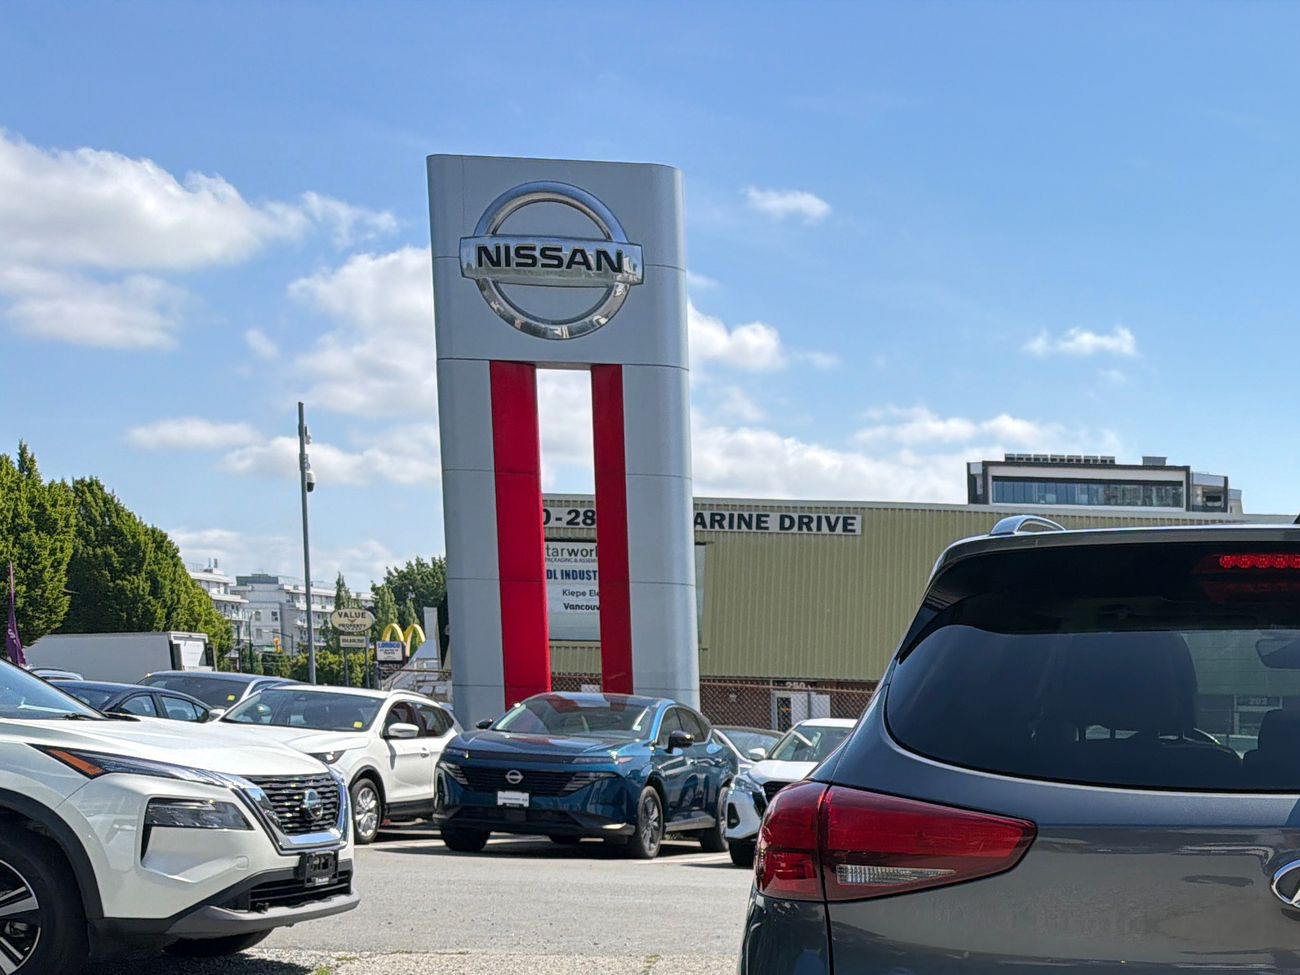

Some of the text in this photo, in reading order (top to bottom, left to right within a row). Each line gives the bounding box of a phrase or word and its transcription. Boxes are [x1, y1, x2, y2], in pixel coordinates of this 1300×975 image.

[477, 244, 624, 274] NISSAN
[694, 511, 857, 533] ARINE DRIVE
[560, 569, 598, 581] INDUST
[562, 588, 587, 598] Kiepe
[337, 611, 367, 619] VALUE
